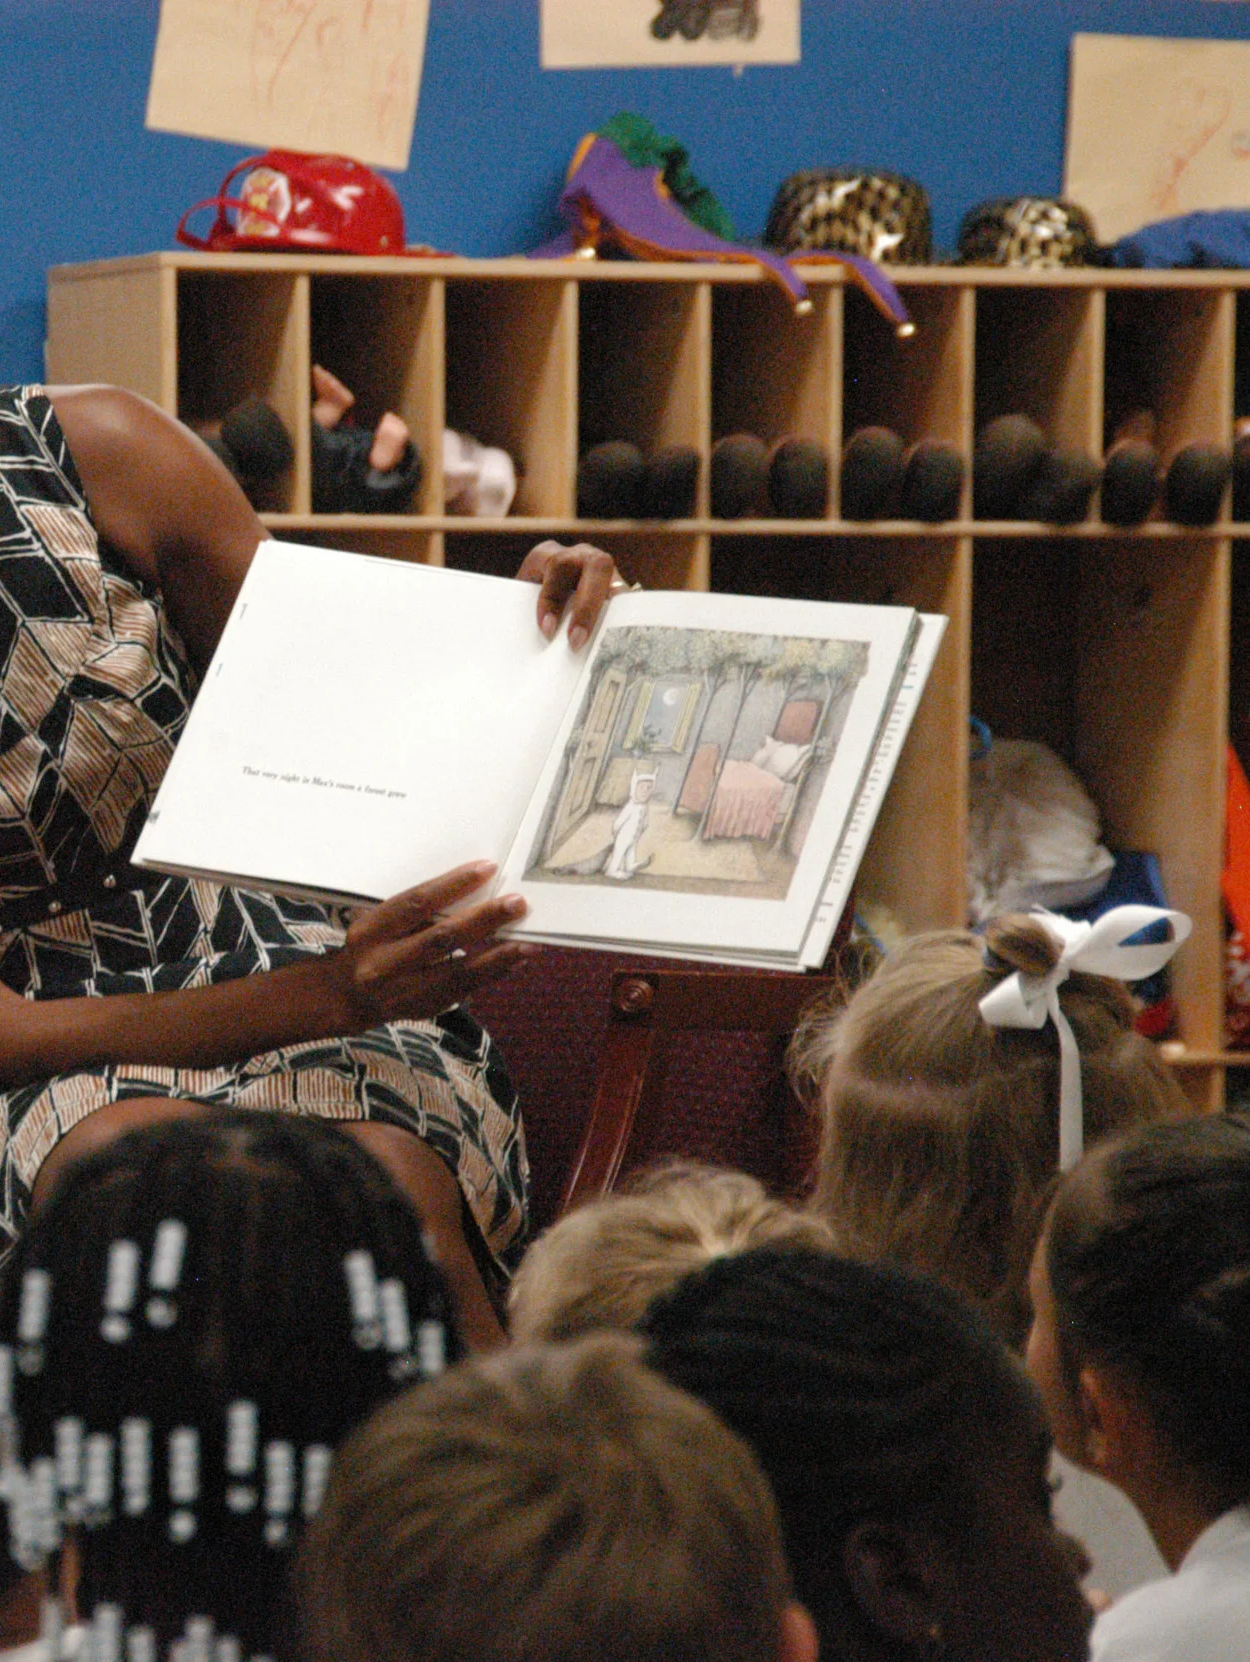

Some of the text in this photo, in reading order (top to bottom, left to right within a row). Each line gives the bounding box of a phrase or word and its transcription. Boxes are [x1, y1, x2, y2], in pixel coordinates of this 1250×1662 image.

[243, 766, 260, 776] That
[262, 772, 278, 780] very
[281, 774, 300, 783] night
[311, 777, 334, 787] Max's
[336, 783, 355, 791] room
[364, 785, 387, 795] forest
